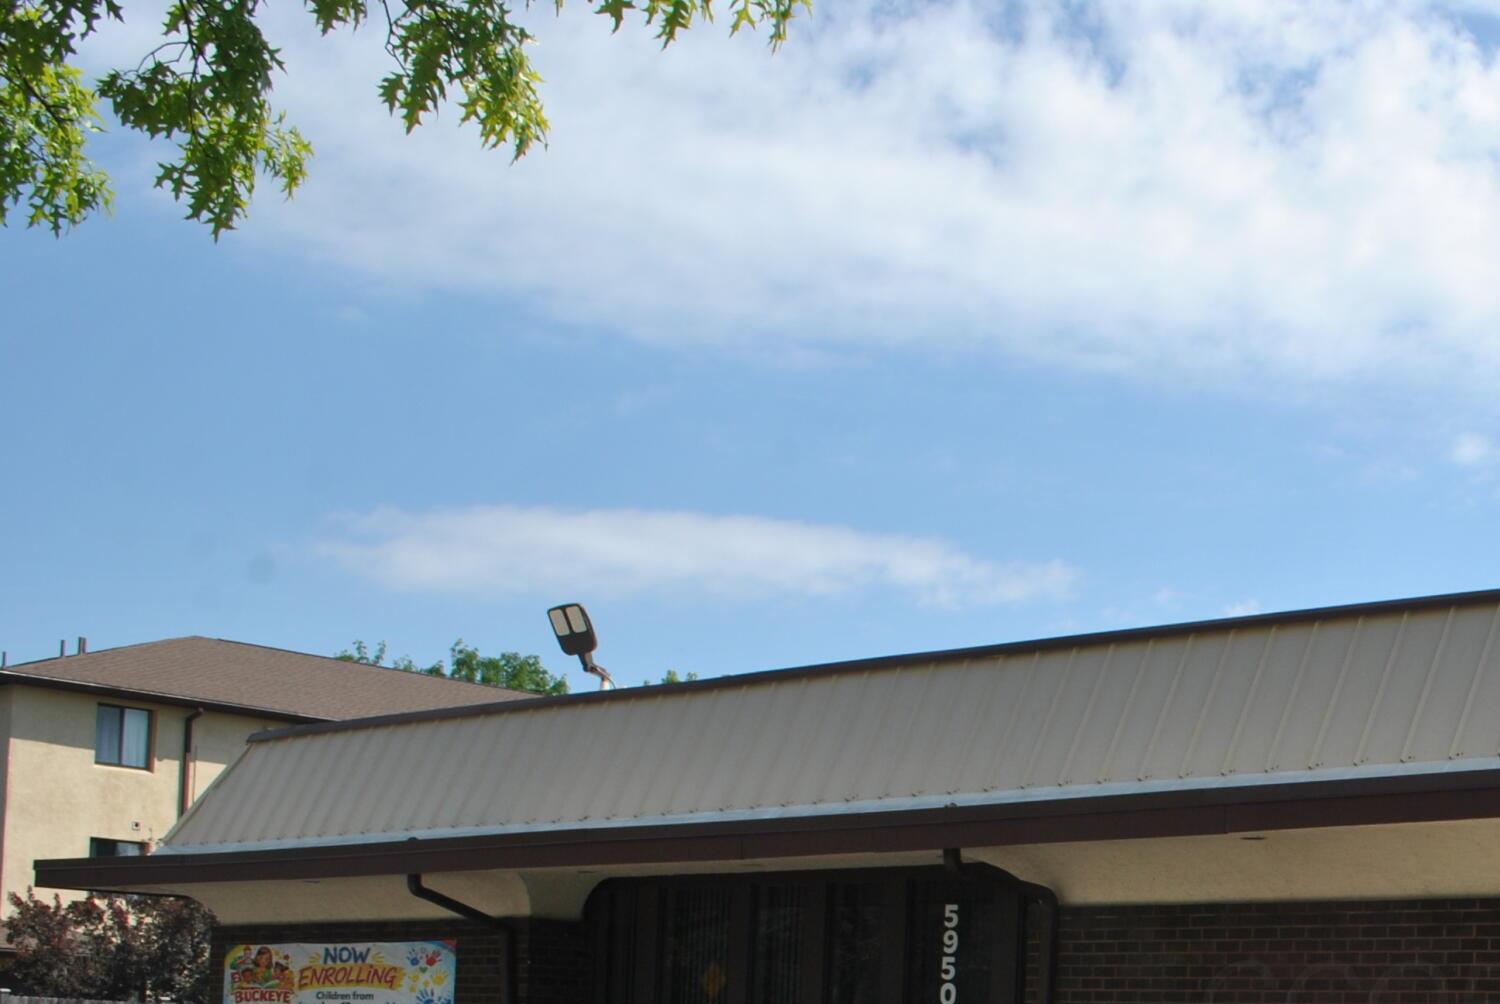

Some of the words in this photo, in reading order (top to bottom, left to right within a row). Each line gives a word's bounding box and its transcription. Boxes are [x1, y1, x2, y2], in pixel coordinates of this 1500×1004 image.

[323, 947, 371, 964] NOW
[234, 989, 291, 1004] BUCKEYE
[316, 991, 351, 1001] Children
[352, 991, 374, 1001] from
